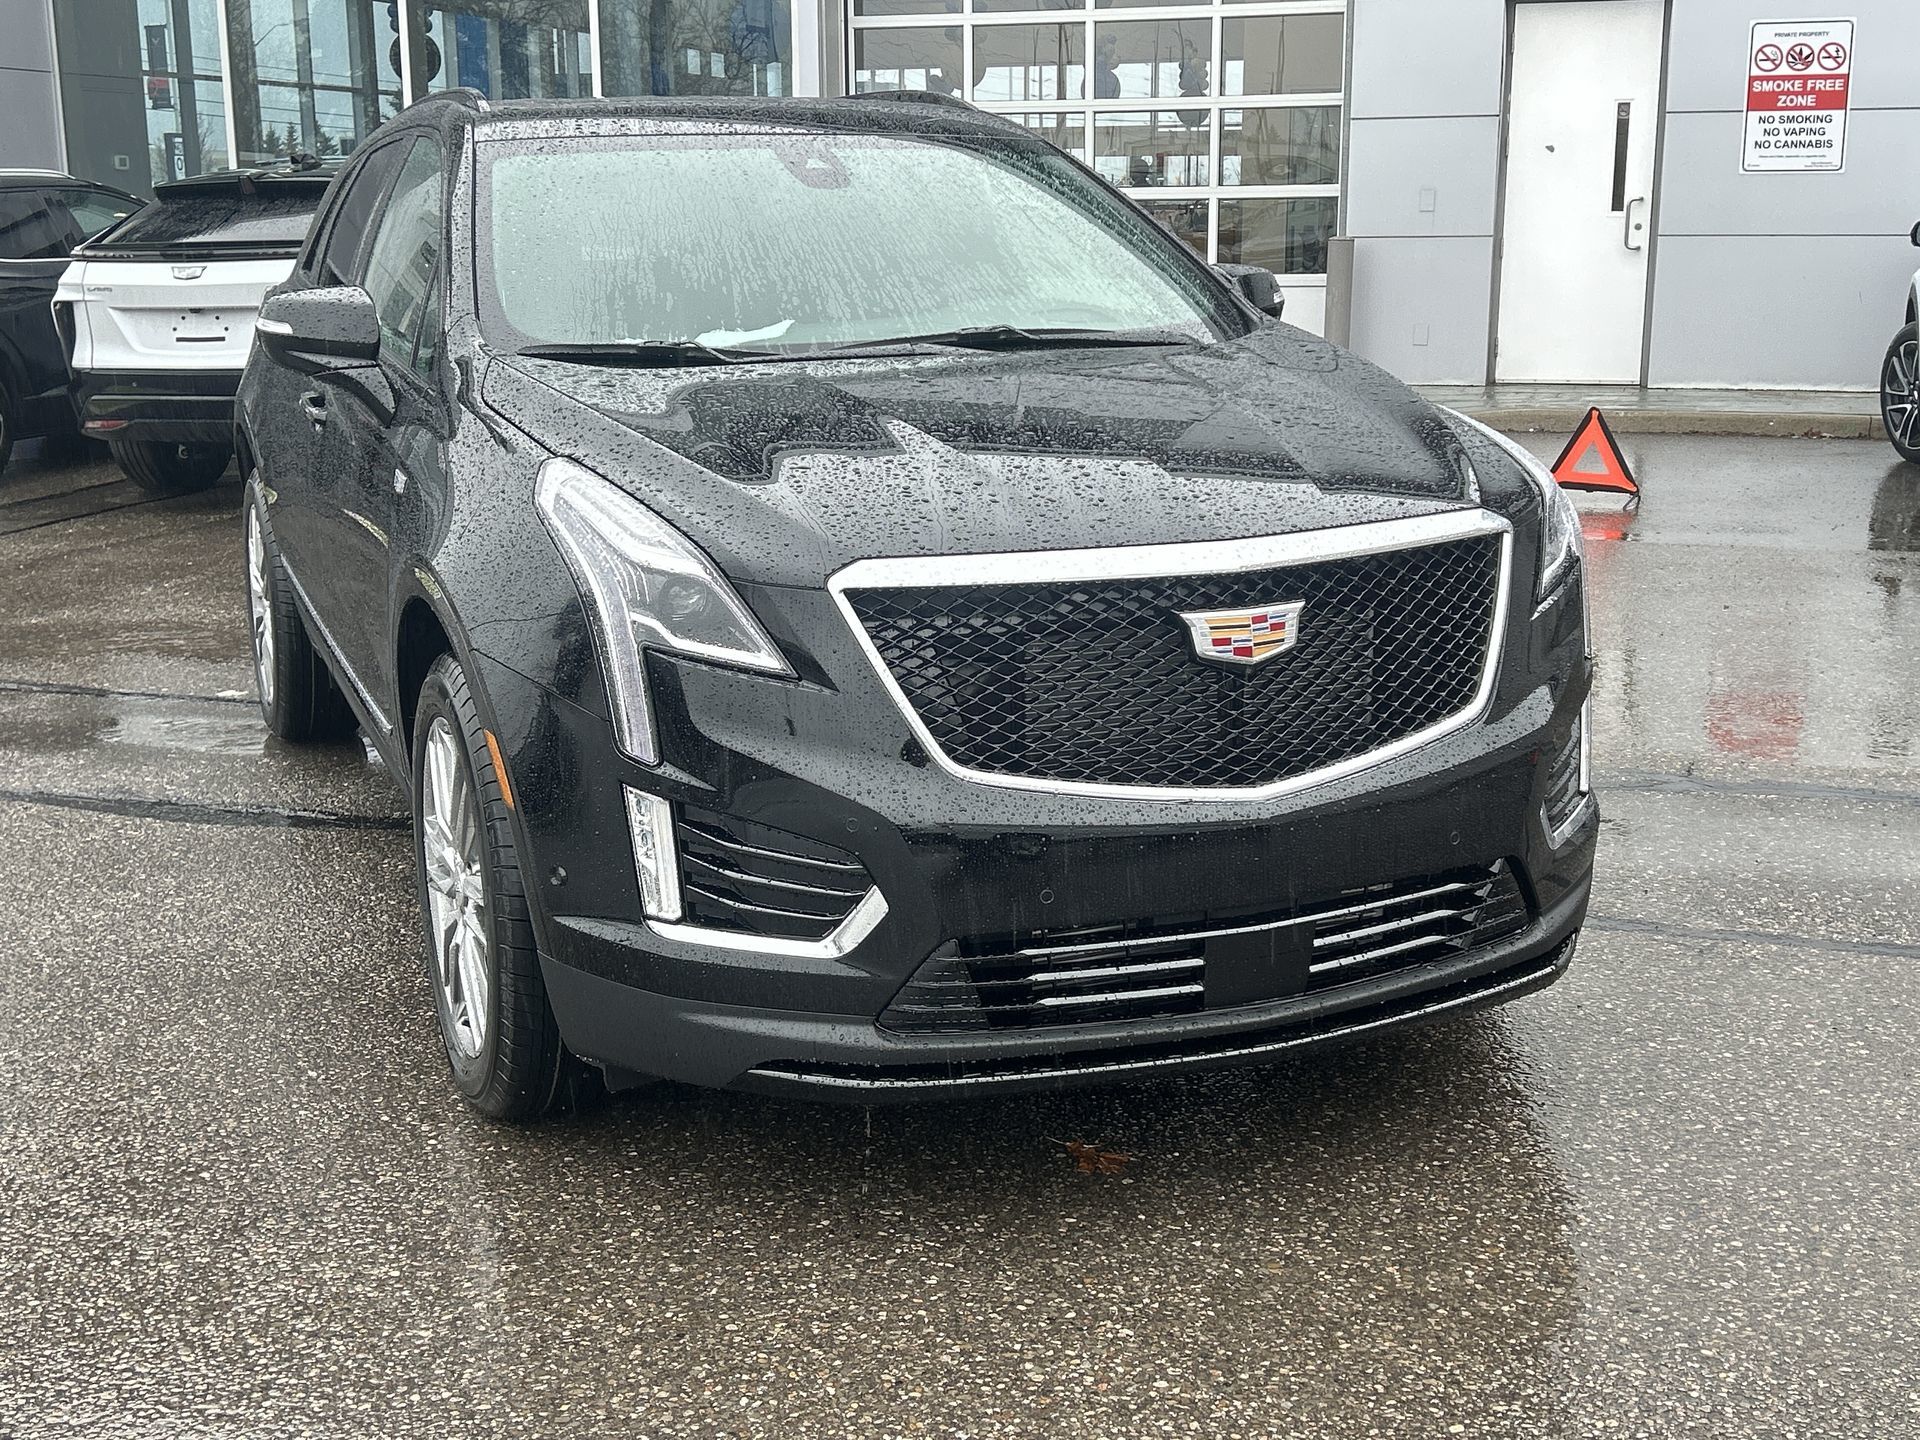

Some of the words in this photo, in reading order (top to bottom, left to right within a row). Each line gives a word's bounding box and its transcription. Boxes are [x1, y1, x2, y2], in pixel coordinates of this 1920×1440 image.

[1752, 80, 1803, 92] SMOKE
[1807, 78, 1845, 91] FREE
[1776, 95, 1817, 107] ZONE
[1758, 115, 1775, 124] NO
[1778, 114, 1833, 124] SMOKING
[1763, 128, 1780, 137] NO
[1783, 127, 1826, 136] VAPING
[1754, 140, 1771, 149] NO
[1774, 139, 1834, 149] CANNABIS
